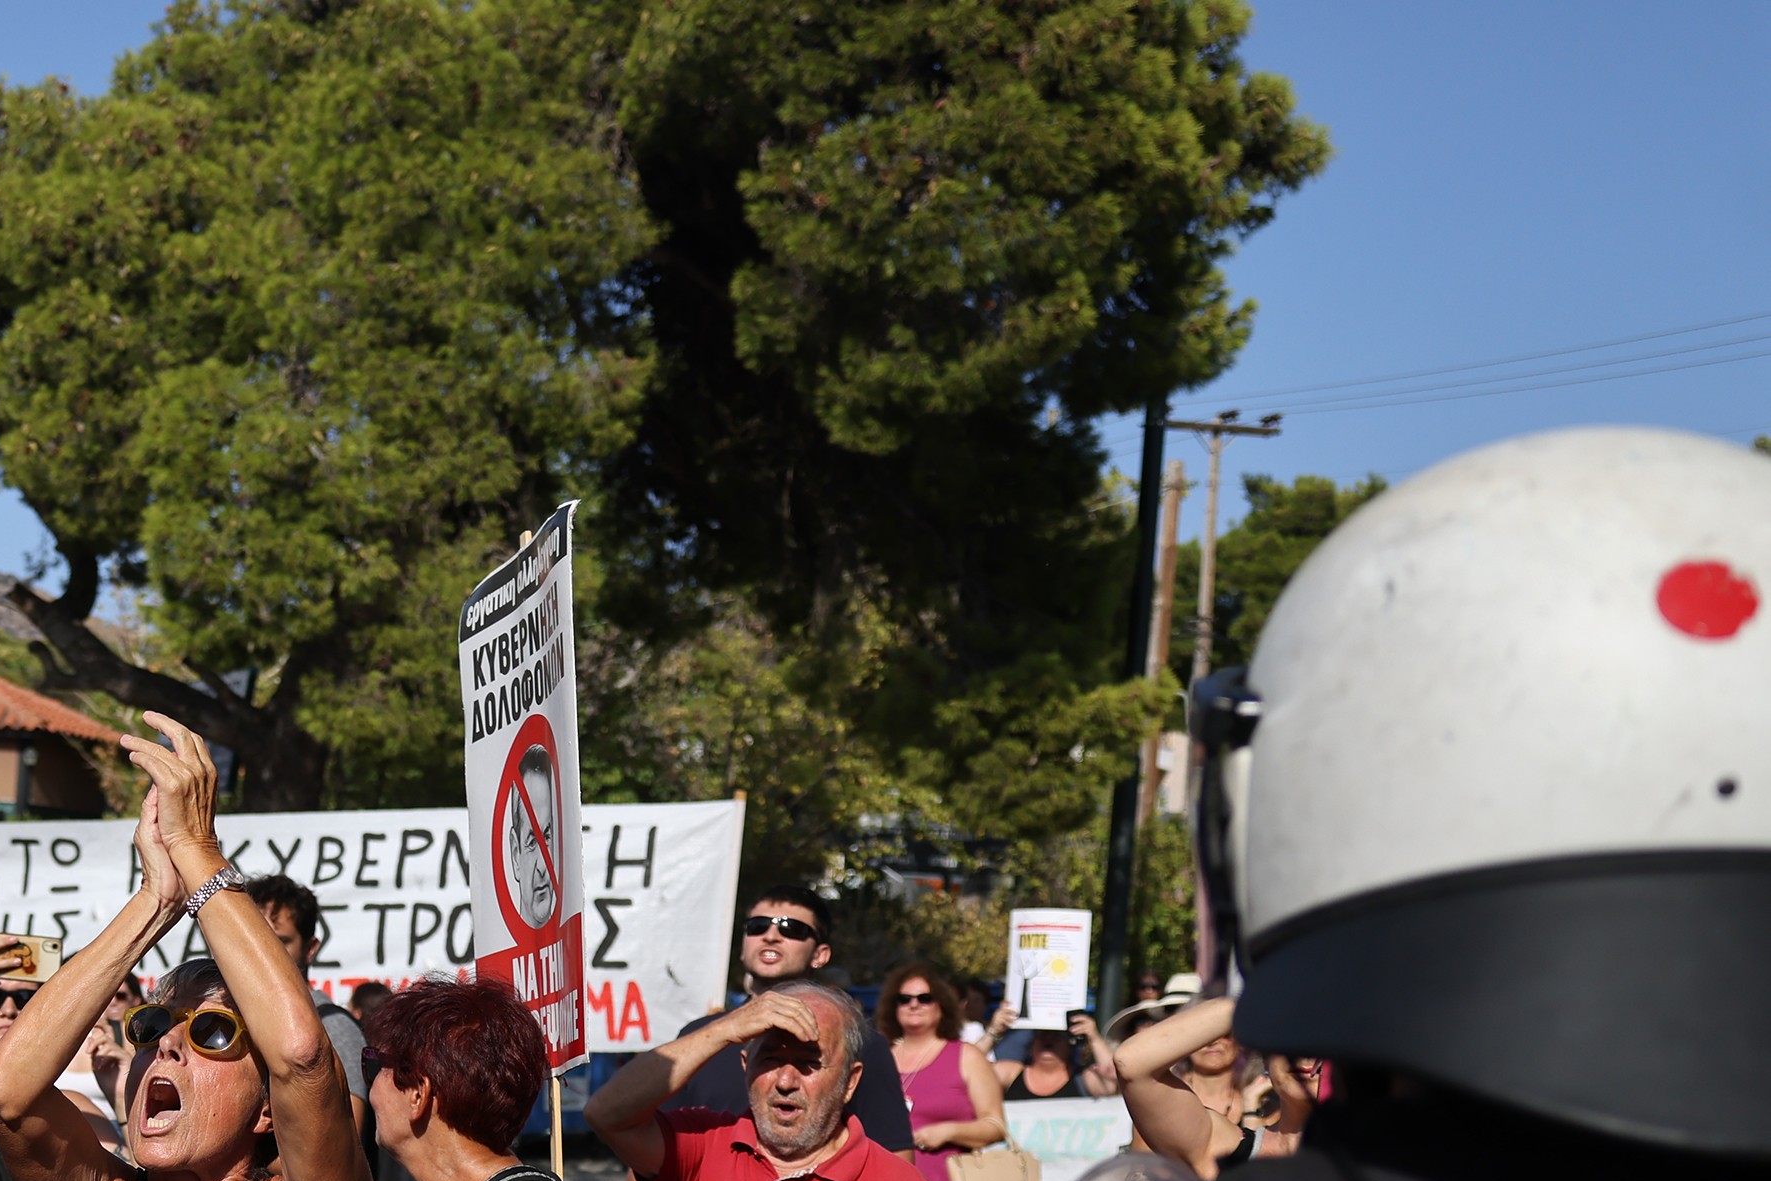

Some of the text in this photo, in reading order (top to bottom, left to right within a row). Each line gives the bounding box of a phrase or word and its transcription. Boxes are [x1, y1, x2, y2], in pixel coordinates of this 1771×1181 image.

[472, 580, 560, 691] ΚΥΒΕΡΝΗΣΗ
[472, 632, 565, 744] ΔΟΛΟΦΟΝΩΝ
[512, 952, 539, 1003] ΝΑ
